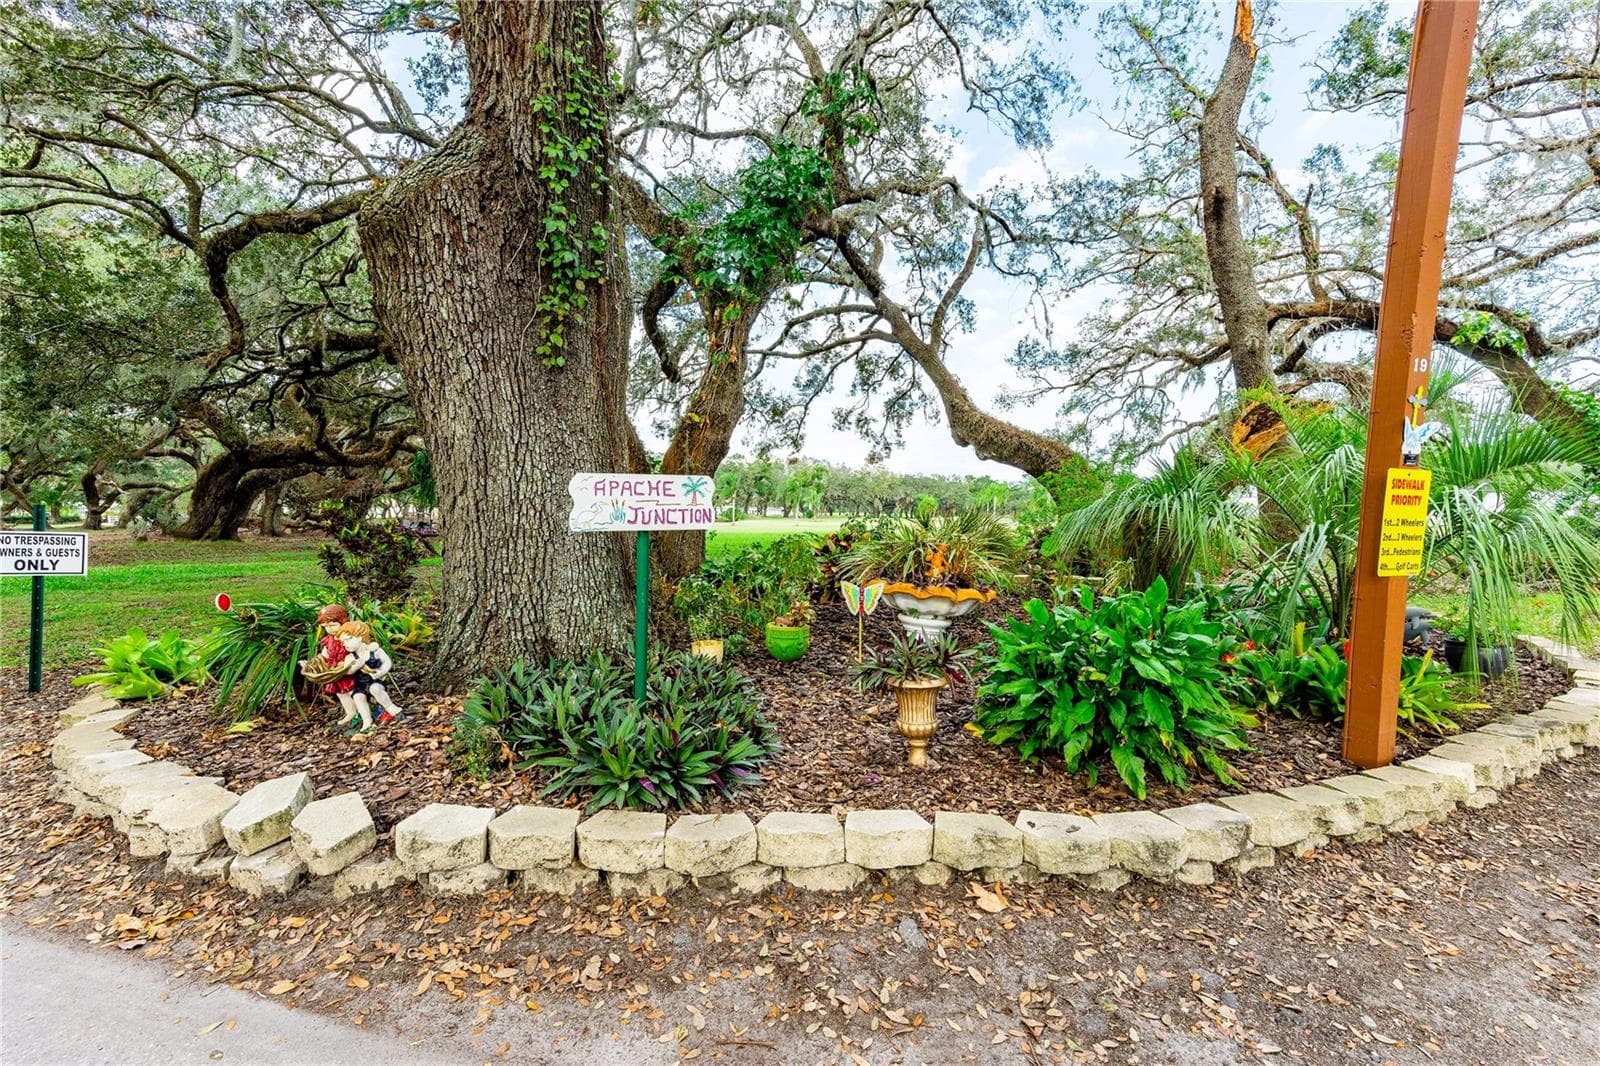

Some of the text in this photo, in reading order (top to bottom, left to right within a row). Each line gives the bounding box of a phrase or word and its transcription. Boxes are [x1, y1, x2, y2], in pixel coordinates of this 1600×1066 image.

[1413, 358, 1428, 373] 19
[593, 478, 676, 497] APACHE
[1391, 478, 1425, 490] SIDEWALK
[1391, 494, 1422, 506] PRIORITY
[626, 505, 712, 525] JUNCTION
[1400, 518, 1424, 527] Wheelers
[0, 535, 77, 546] NO TRESPASSING
[1401, 533, 1422, 541] Wheelers
[0, 548, 80, 557] WNERS & GUESTS
[14, 559, 60, 571] ONLY
[1406, 562, 1419, 570] Carts
